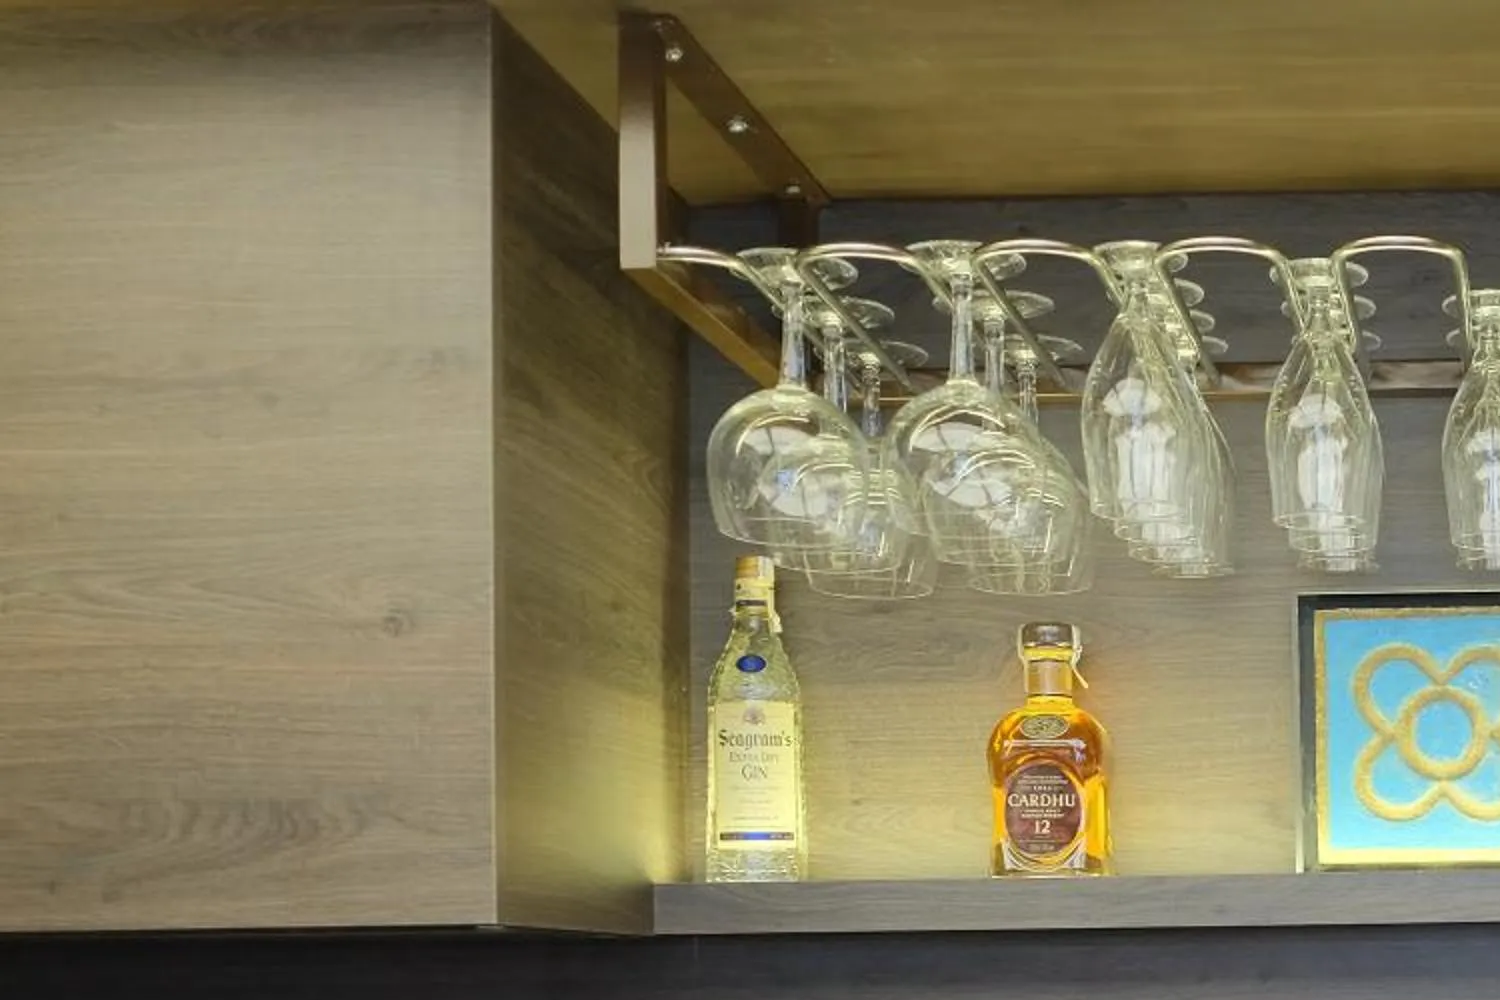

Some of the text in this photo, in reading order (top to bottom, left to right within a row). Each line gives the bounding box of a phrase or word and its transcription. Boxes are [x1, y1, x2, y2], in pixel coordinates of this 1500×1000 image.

[718, 729, 791, 751] Seagram's
[741, 763, 767, 781] GIN
[1007, 793, 1076, 808] CARDHU
[1034, 819, 1051, 834] 12
